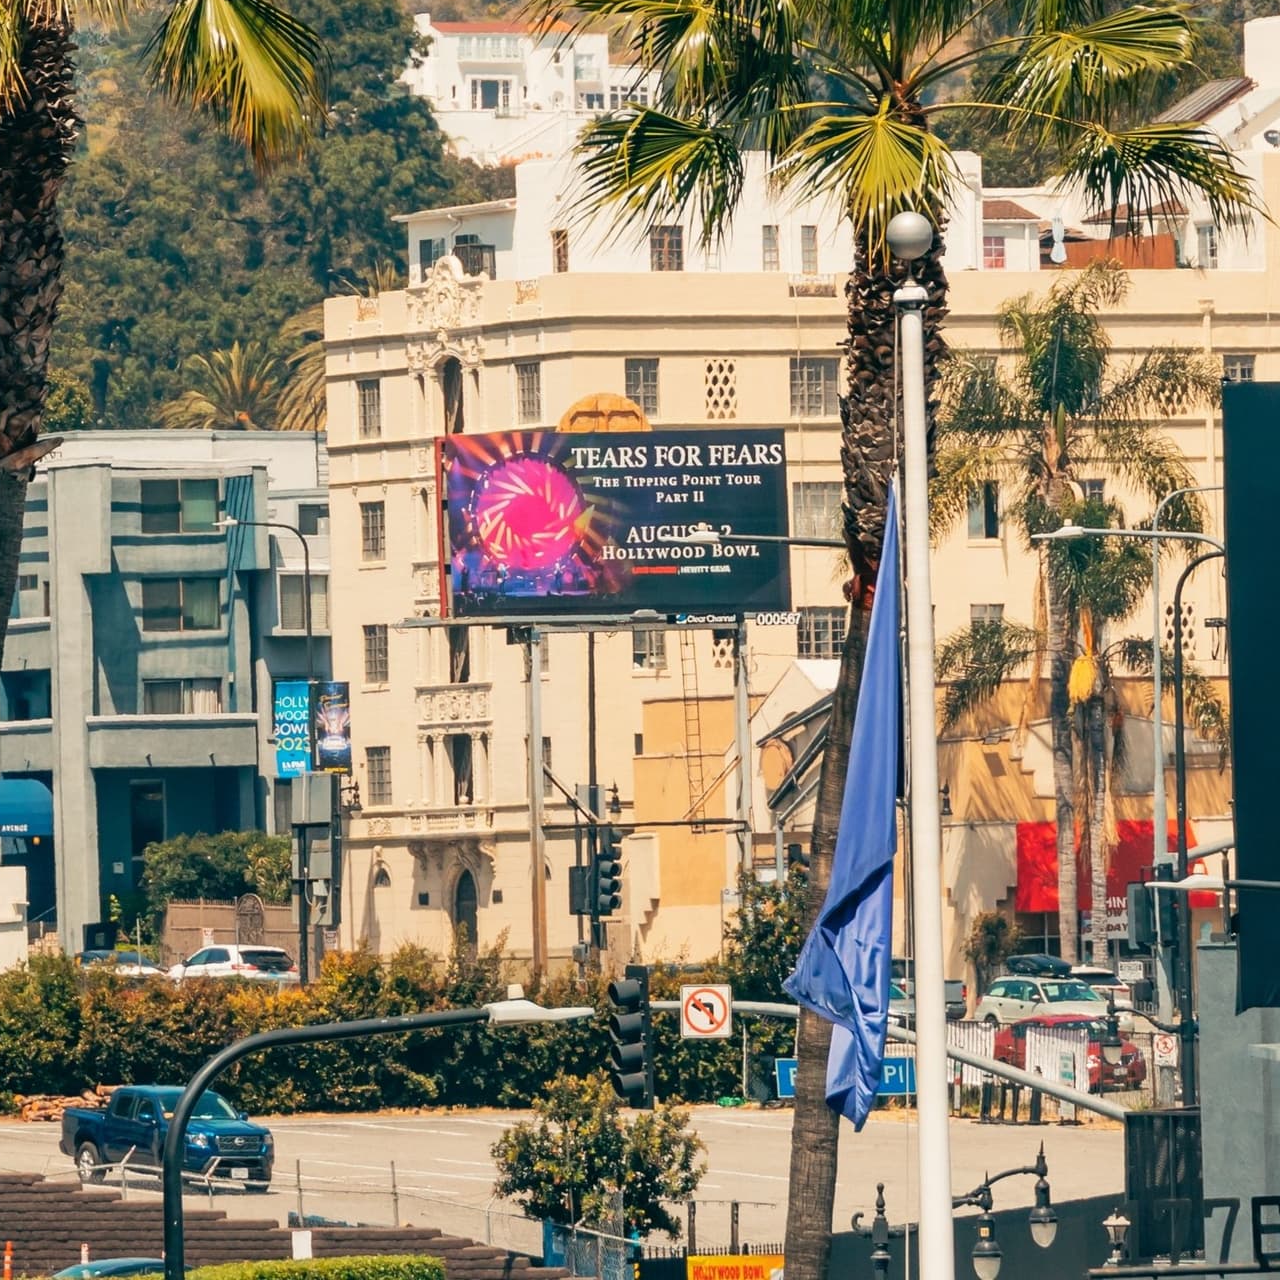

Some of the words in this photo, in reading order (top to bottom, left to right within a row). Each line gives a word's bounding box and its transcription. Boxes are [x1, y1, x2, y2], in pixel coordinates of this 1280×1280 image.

[572, 446, 647, 470] TEARS
[656, 445, 702, 468] FOR
[709, 443, 783, 467] FEARS
[593, 476, 619, 488] THE
[624, 475, 677, 488] TIPPING
[682, 474, 720, 486] POINT
[725, 473, 761, 486] TOUR
[656, 491, 688, 504] PART
[602, 545, 706, 561] HOLLYWOOD
[712, 543, 760, 558] BOWL
[757, 612, 801, 626] 000567
